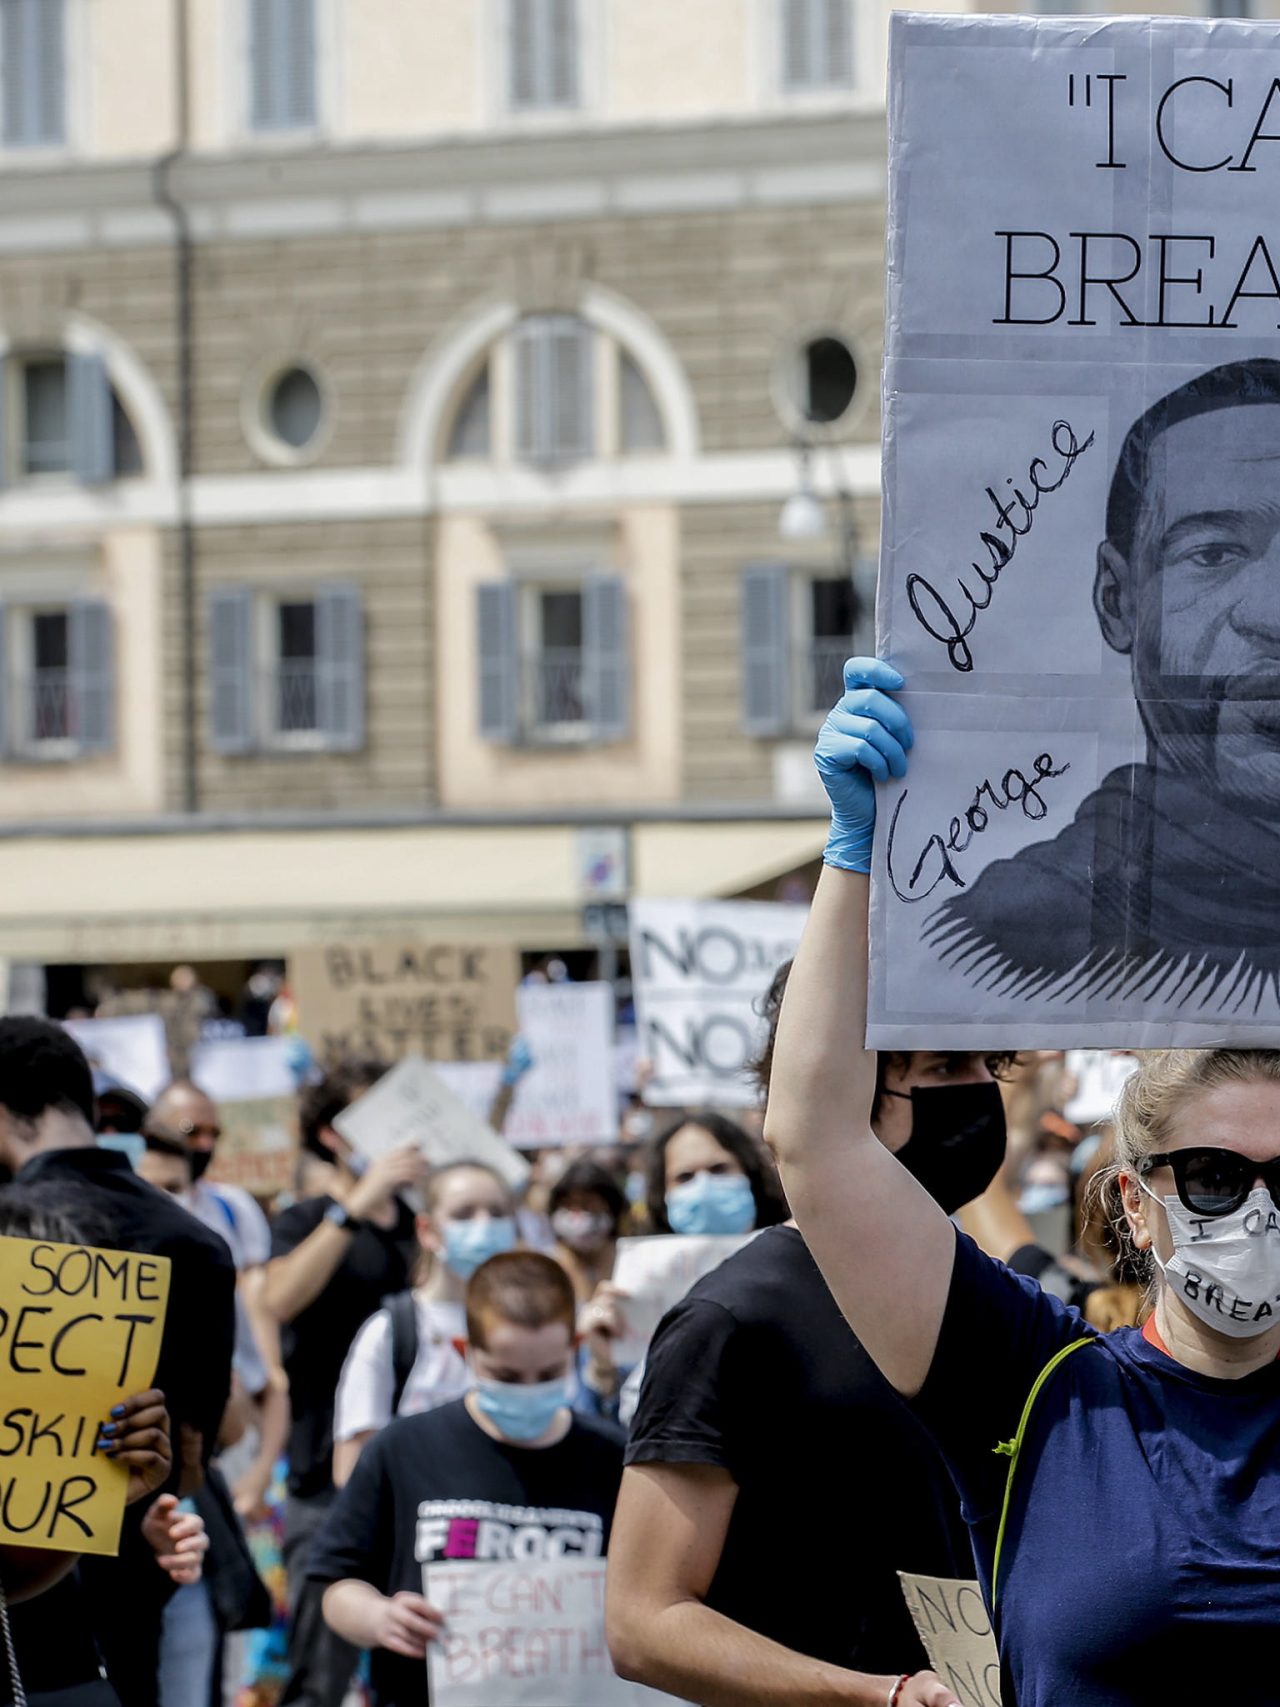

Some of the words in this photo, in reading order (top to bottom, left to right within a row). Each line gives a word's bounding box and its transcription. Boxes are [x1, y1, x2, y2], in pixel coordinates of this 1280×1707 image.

[906, 419, 1095, 672] Justice
[887, 753, 1071, 903] George
[323, 944, 487, 988] BLACK
[648, 1012, 750, 1078] NO
[21, 1245, 159, 1301] SOME
[415, 1516, 603, 1562] FEROCI
[430, 1573, 474, 1617] I
[915, 1583, 992, 1636] NO
